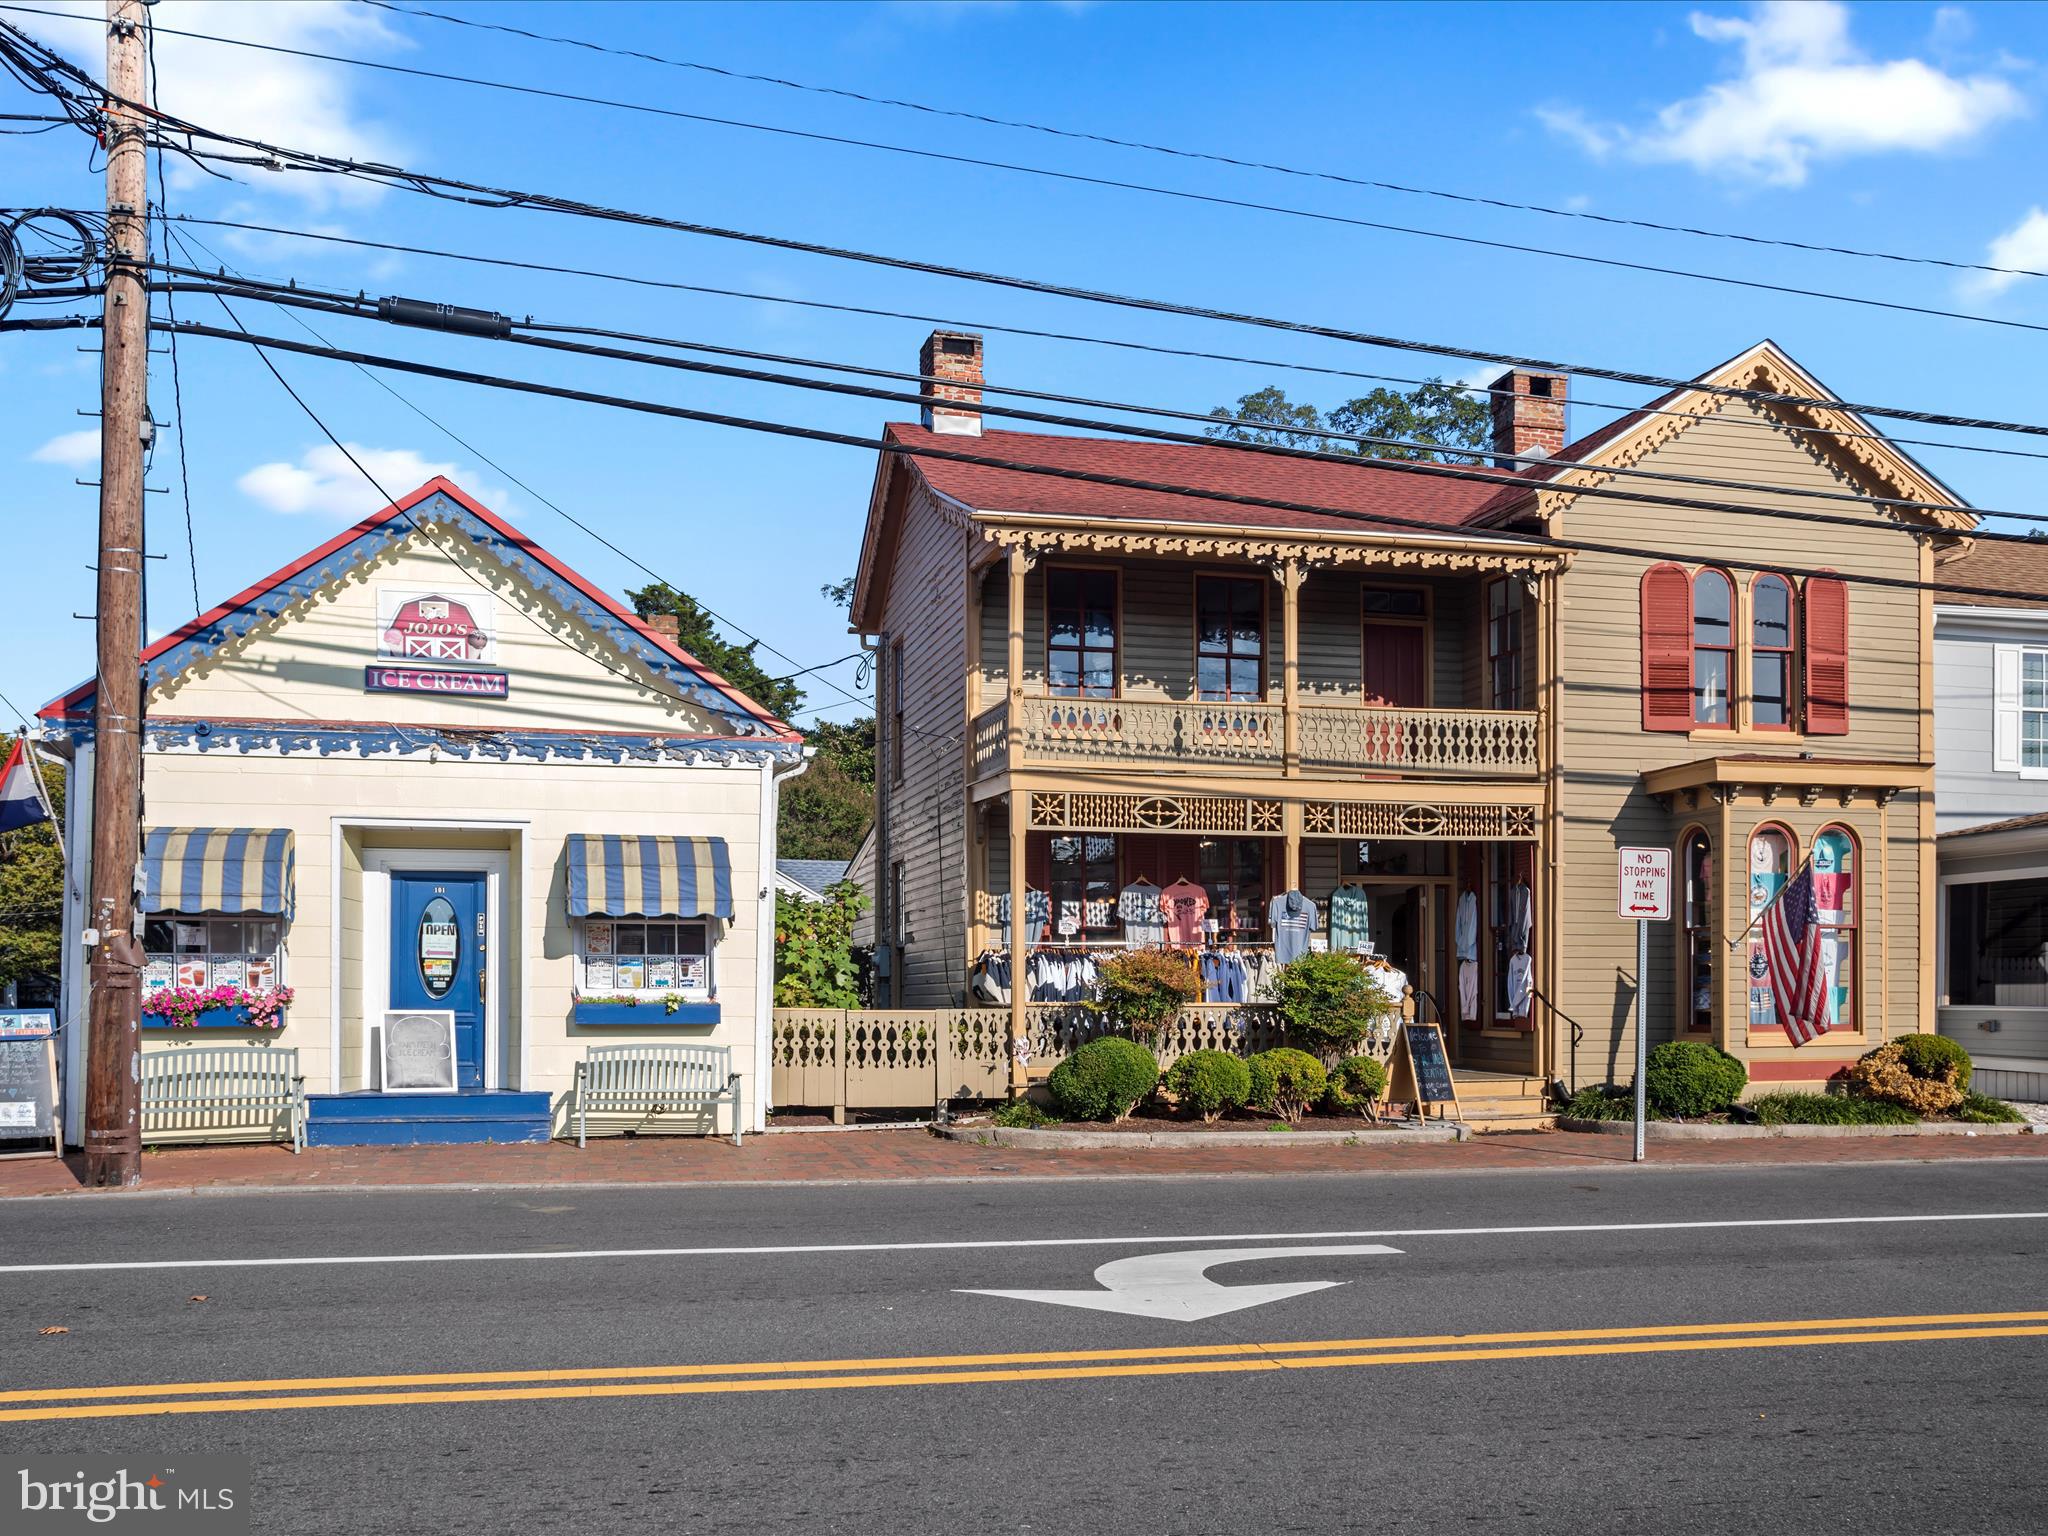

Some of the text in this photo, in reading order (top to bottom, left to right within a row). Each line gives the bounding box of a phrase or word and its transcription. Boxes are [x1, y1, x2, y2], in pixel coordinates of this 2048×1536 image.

[404, 622, 468, 636] JOJO'S
[372, 671, 502, 692] ICE CREAM
[1637, 854, 1653, 864] NO
[1624, 866, 1666, 878] STOPPING
[1635, 880, 1654, 889] ANY
[1633, 891, 1655, 901] TIME
